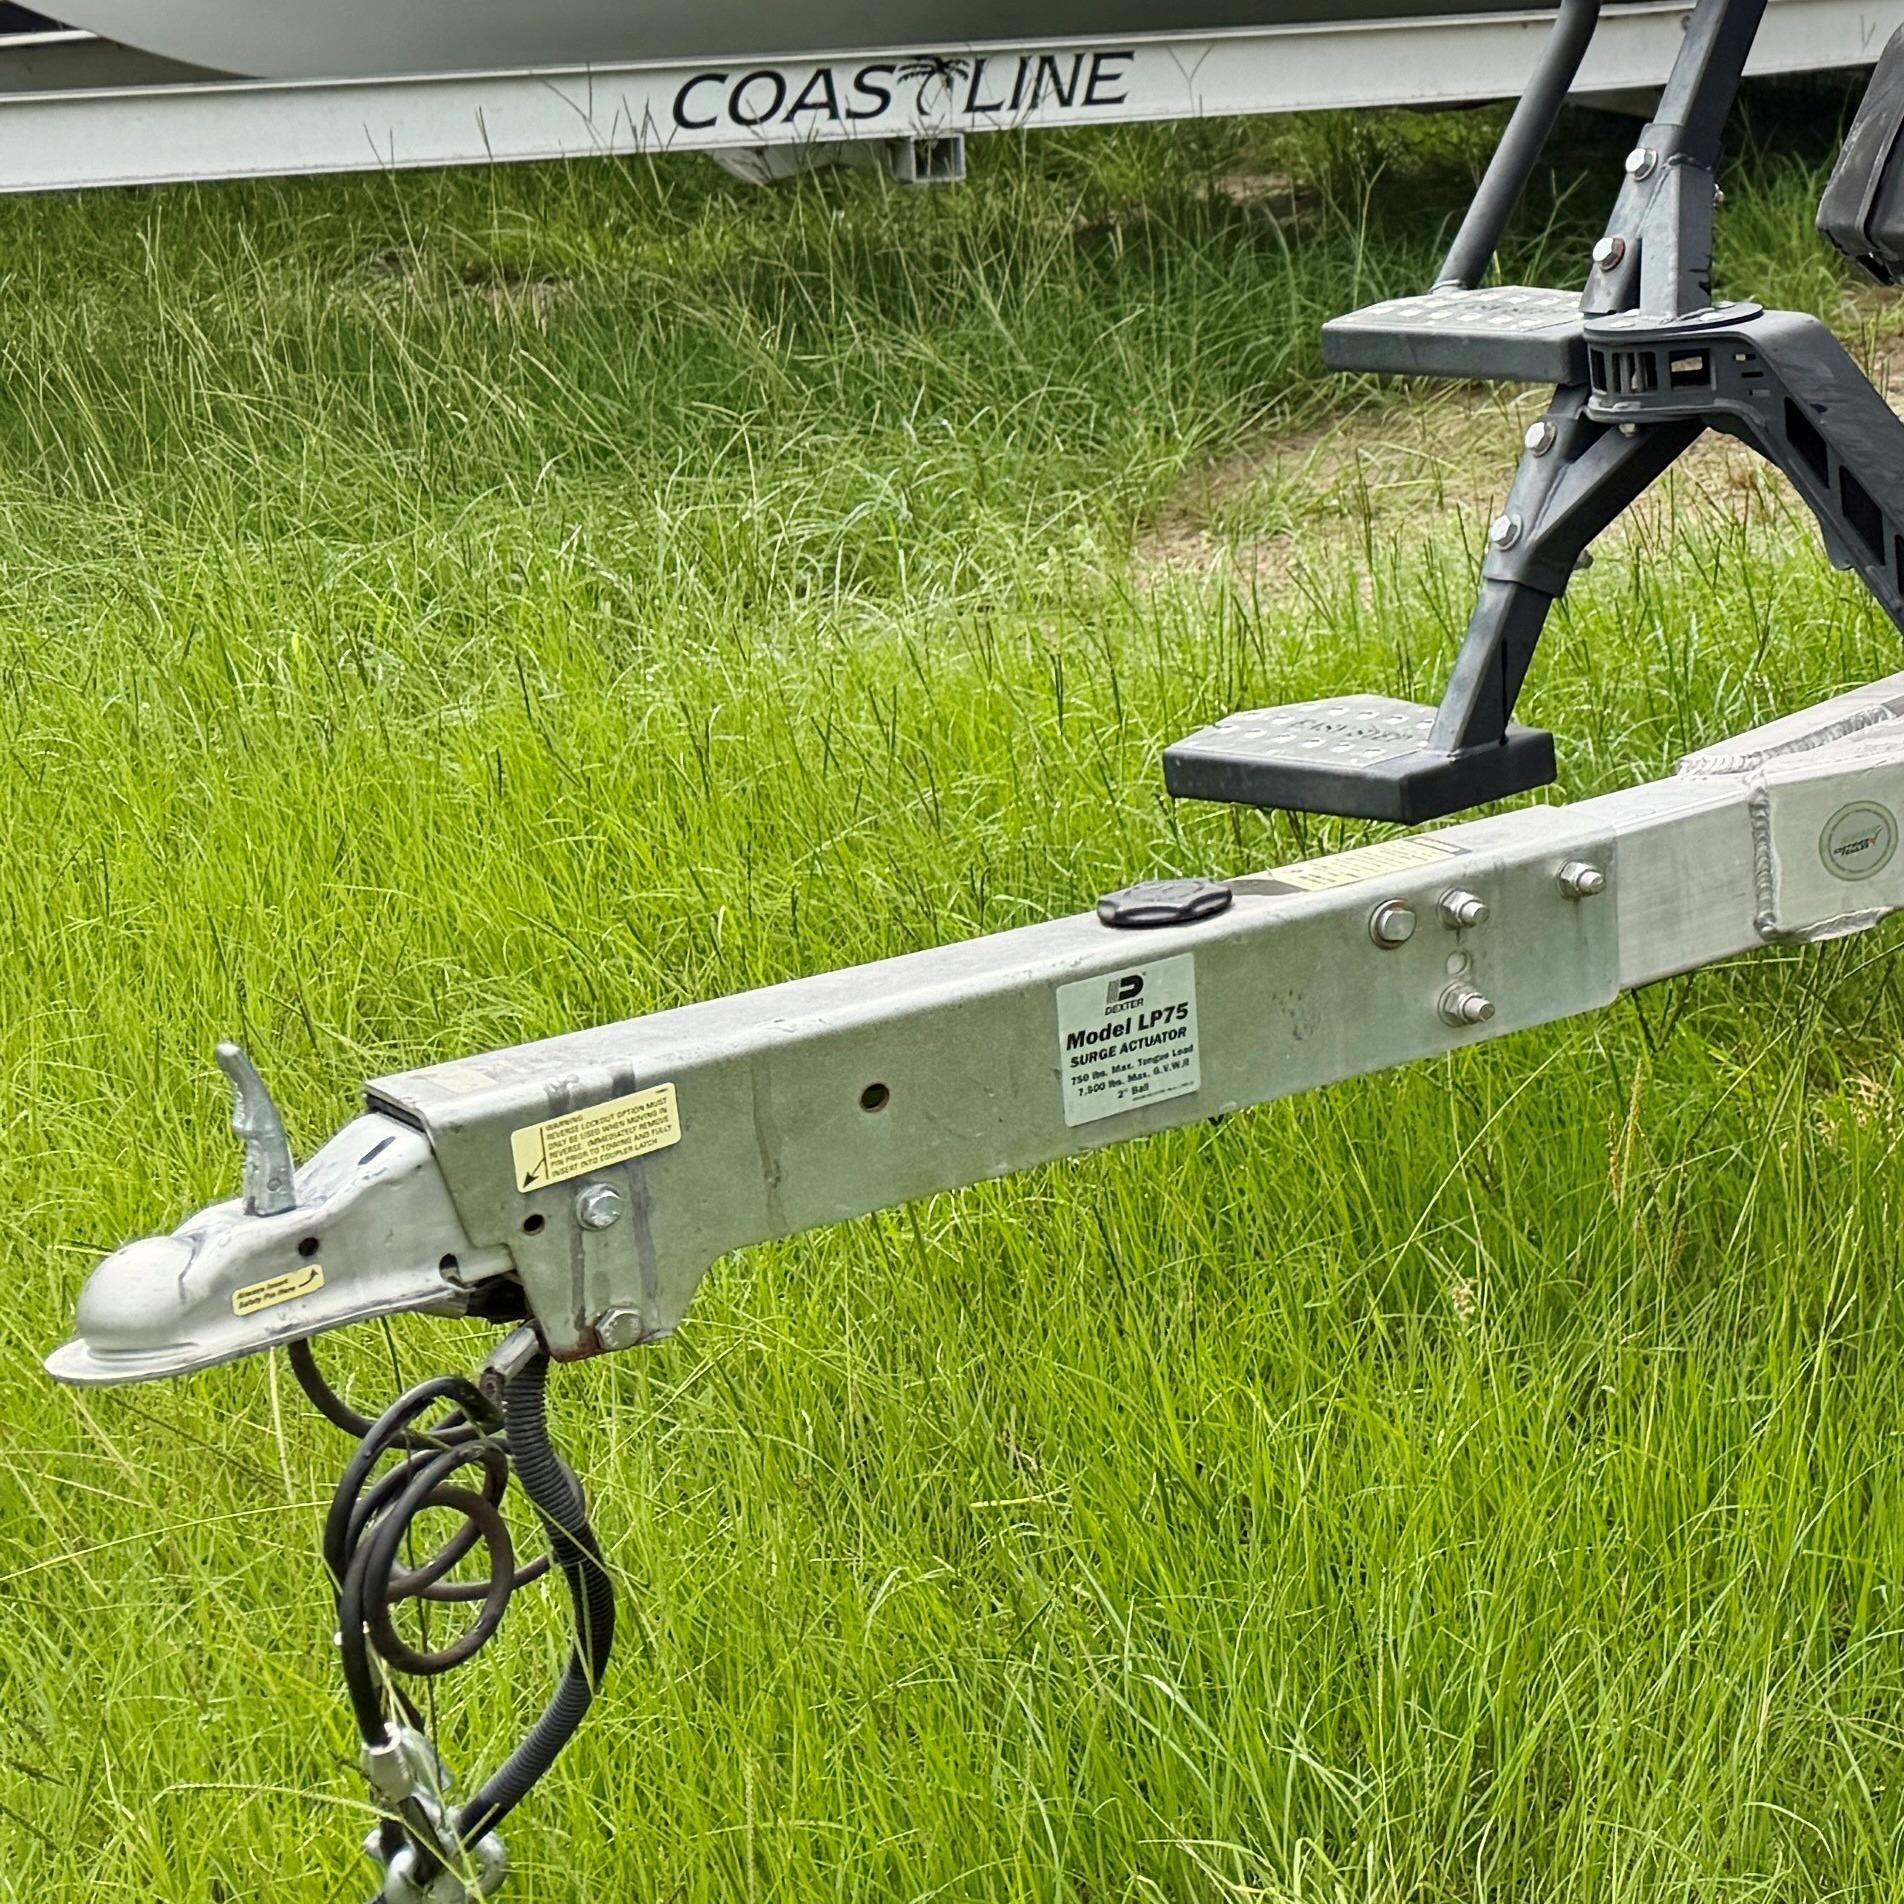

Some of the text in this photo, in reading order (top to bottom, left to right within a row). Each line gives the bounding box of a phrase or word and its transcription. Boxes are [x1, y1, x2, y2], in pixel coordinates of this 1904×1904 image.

[1104, 998, 1144, 1016] DEXTER
[1066, 1002, 1189, 1051] Model LP75
[1070, 1026, 1187, 1068] SURGE ACTUATOR
[1071, 1044, 1194, 1086] 750 lbs. Max. Tongue Load
[1108, 1078, 1124, 1088] lbs.
[1128, 1071, 1150, 1083] Max.
[1132, 1083, 1149, 1095] Ball
